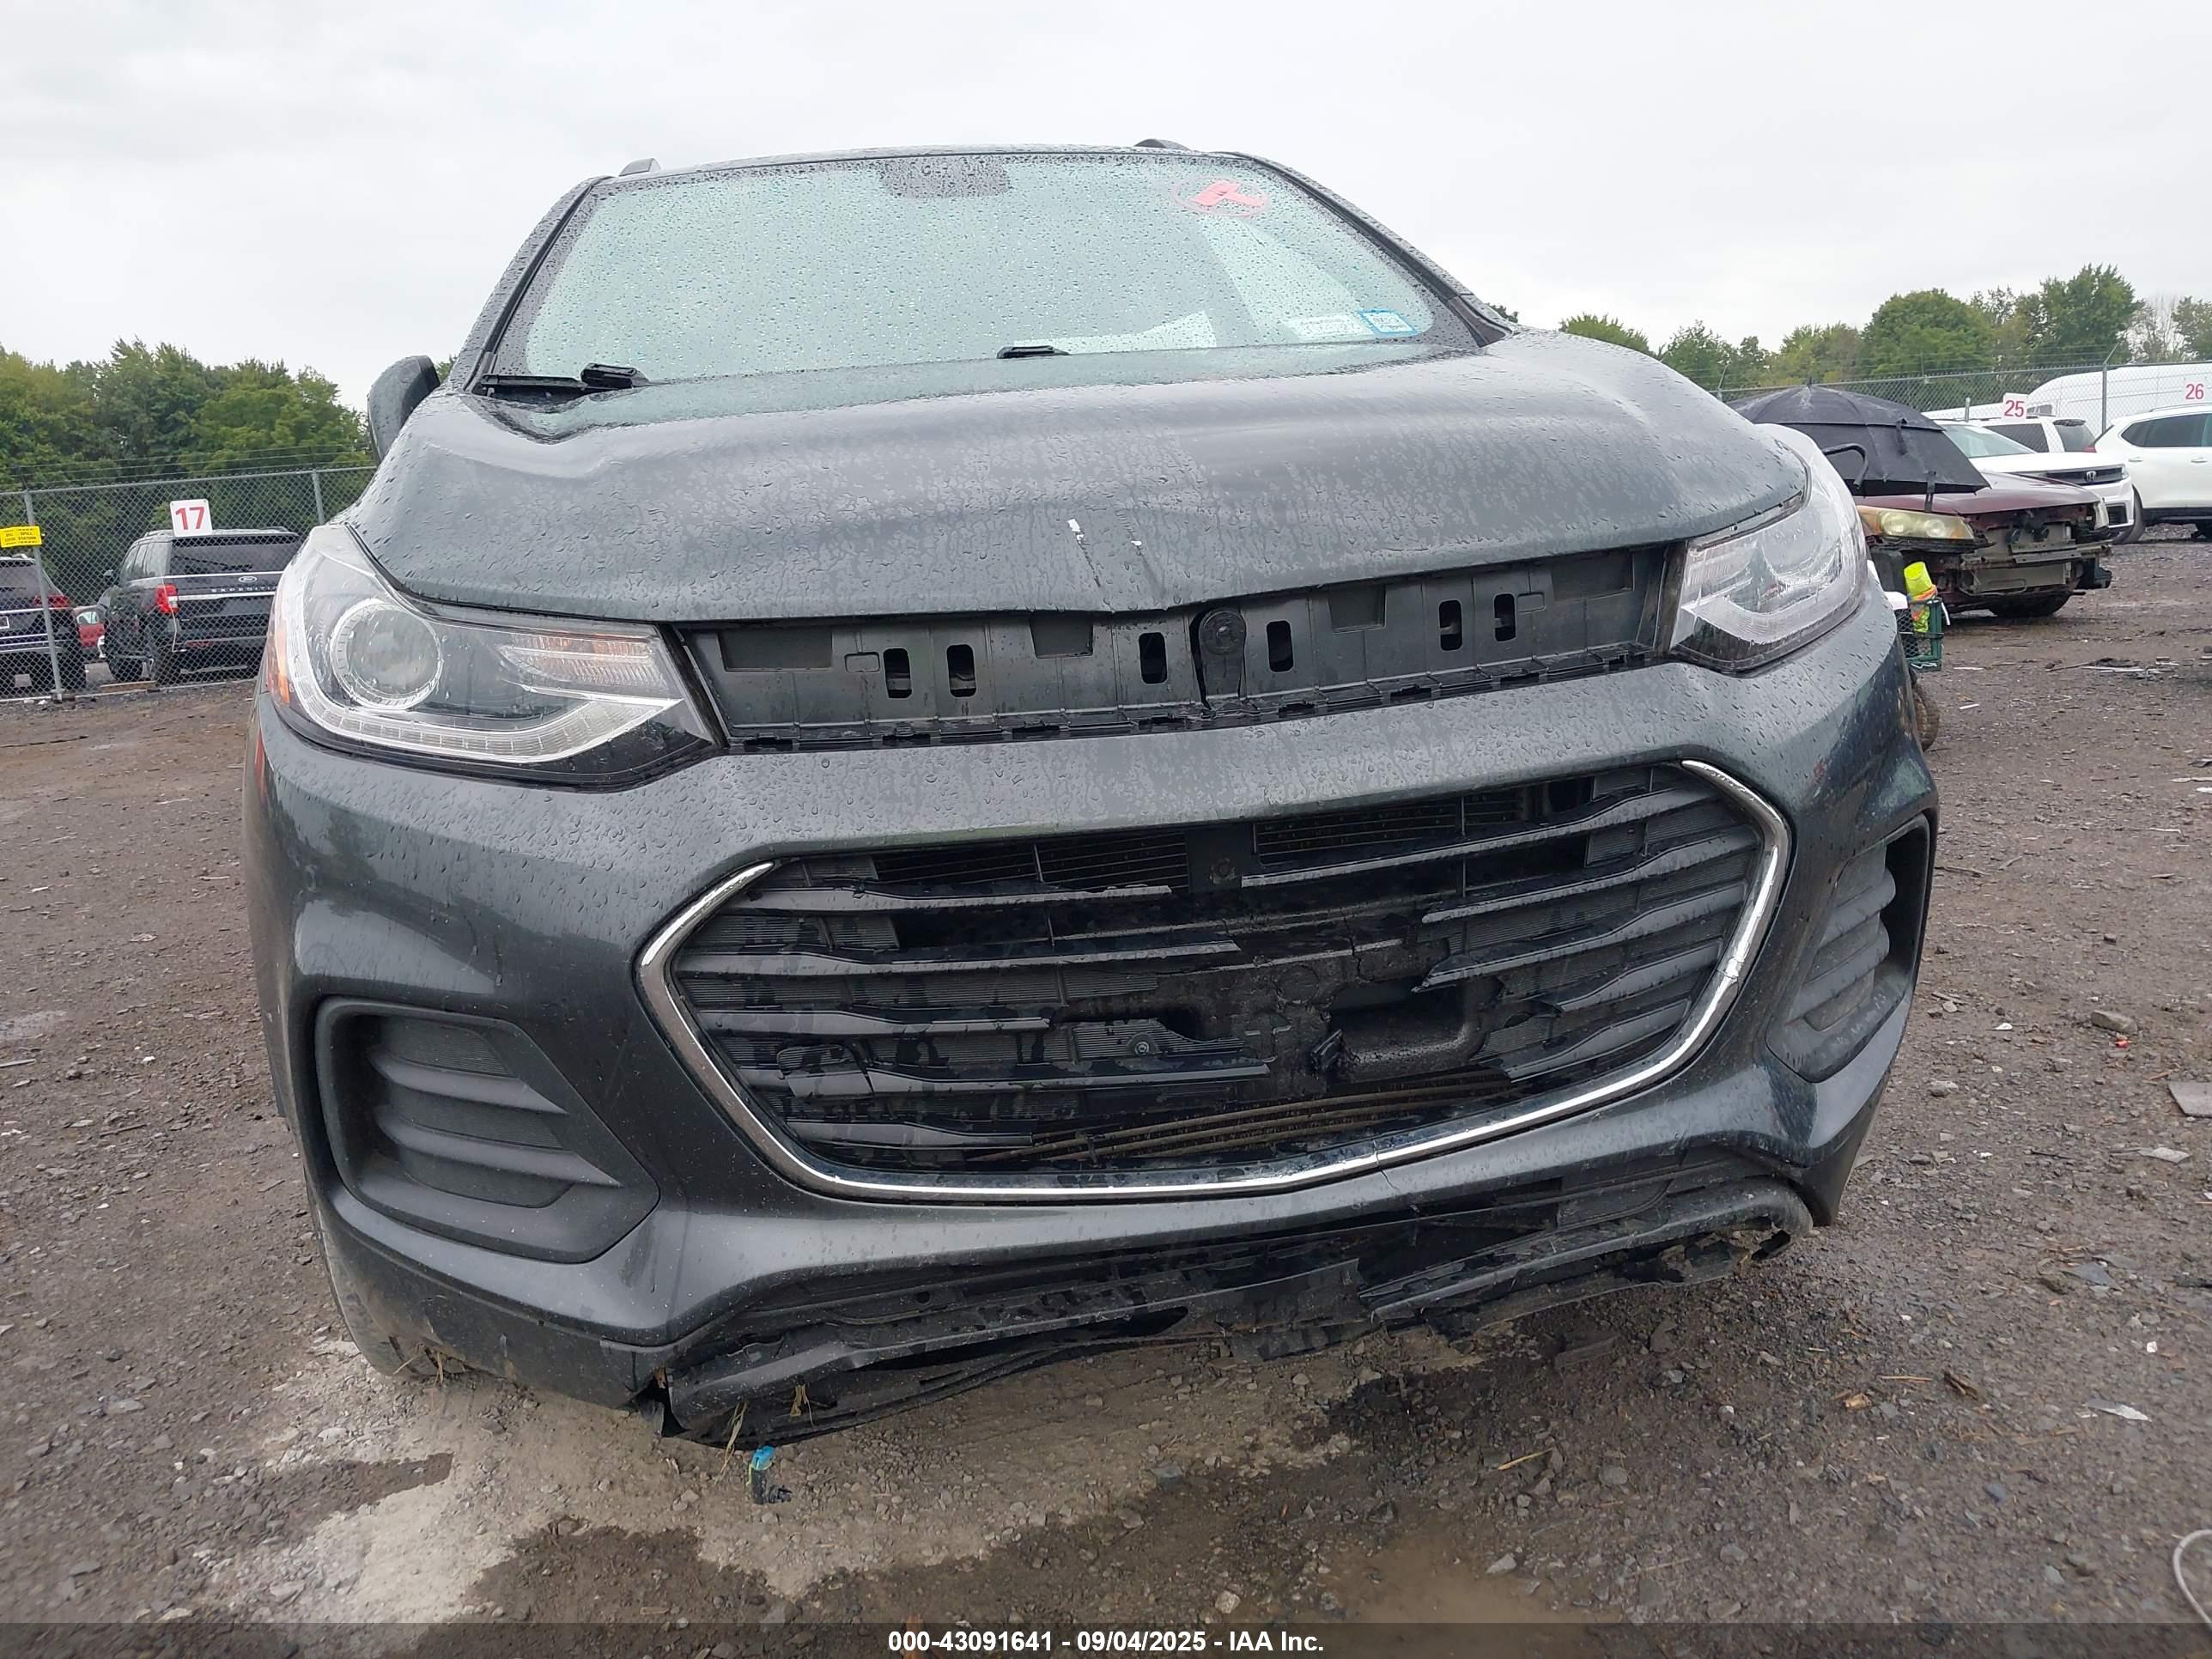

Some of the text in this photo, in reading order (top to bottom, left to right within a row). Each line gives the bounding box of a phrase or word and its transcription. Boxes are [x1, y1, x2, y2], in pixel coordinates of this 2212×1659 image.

[2185, 383, 2204, 400] 26
[2003, 399, 2025, 417] 25
[175, 507, 205, 530] 17
